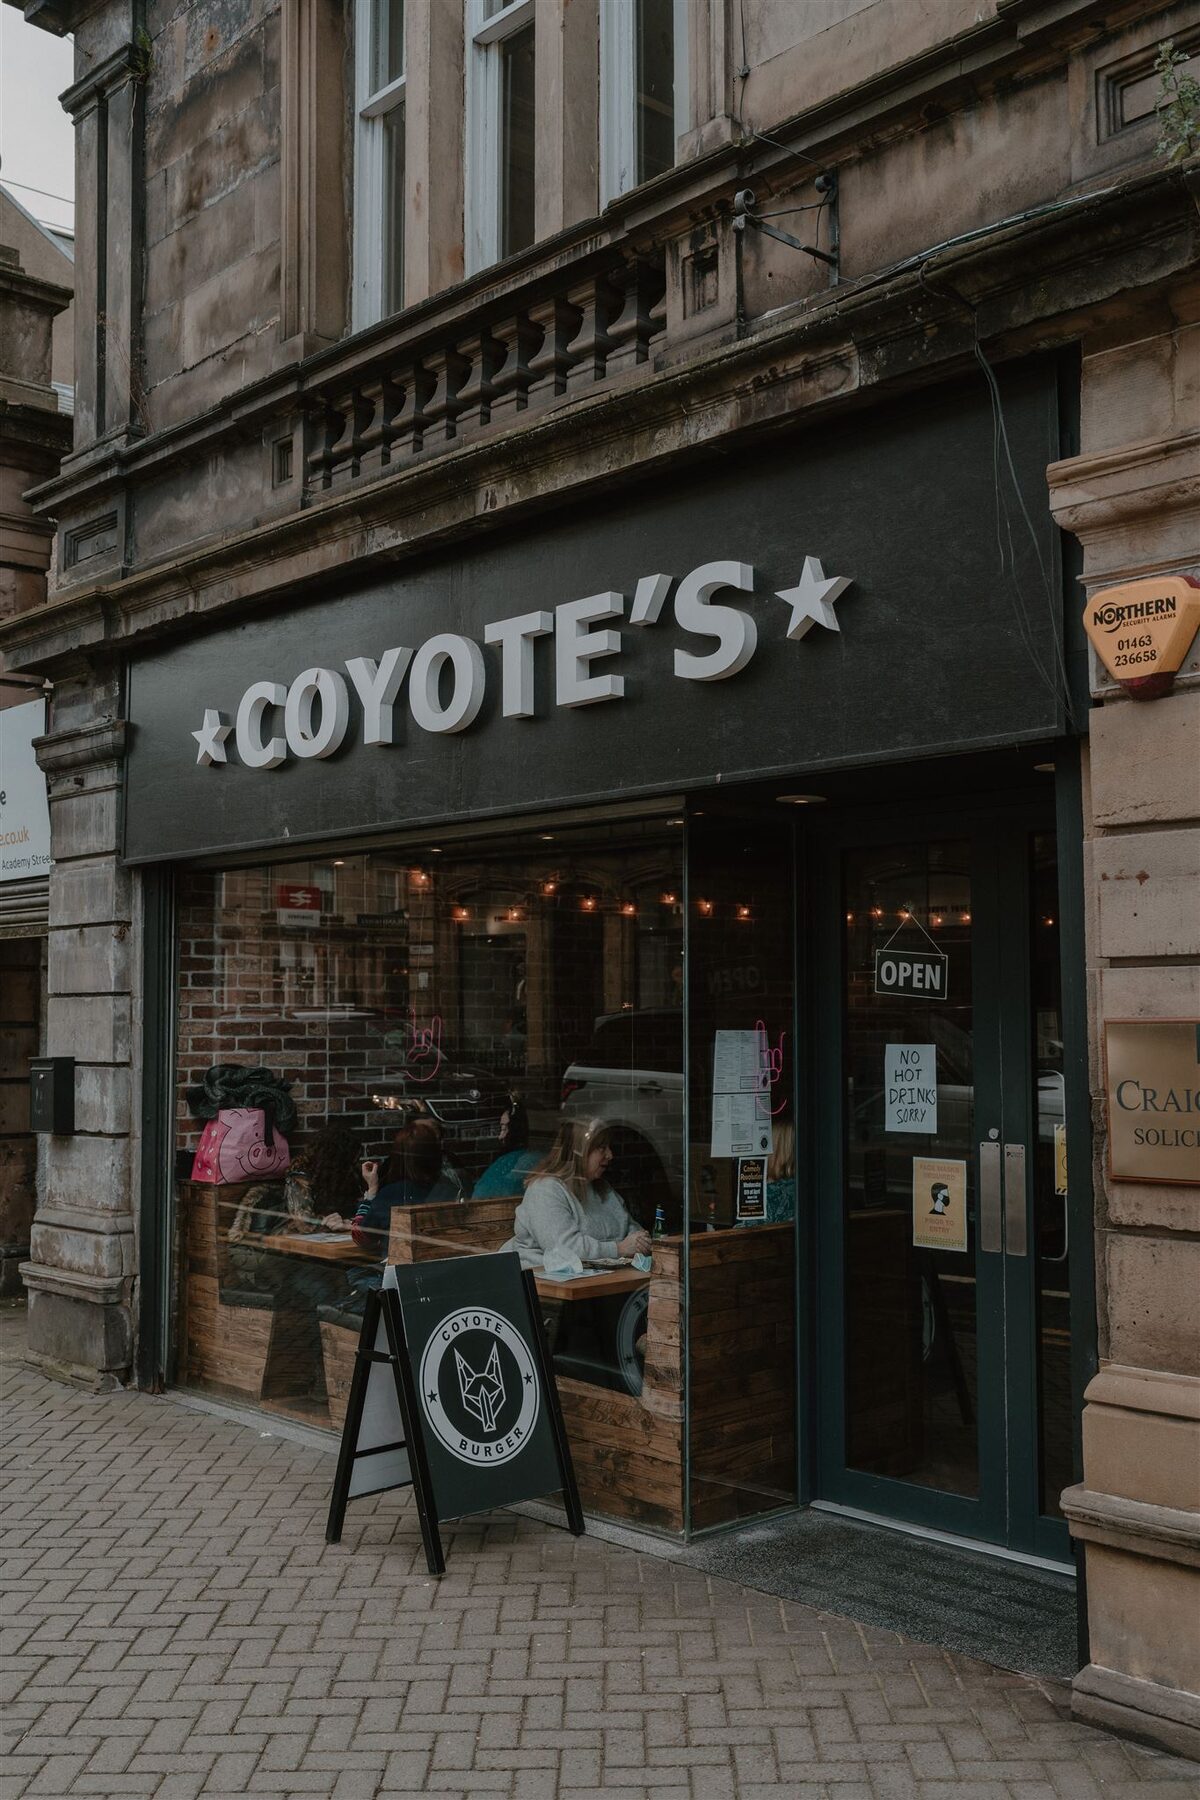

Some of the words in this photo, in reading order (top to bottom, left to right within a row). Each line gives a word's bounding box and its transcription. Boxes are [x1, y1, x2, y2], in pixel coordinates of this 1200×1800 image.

[1093, 596, 1177, 626] NORTHERN
[1122, 617, 1150, 628] SECURITY
[1152, 613, 1177, 623] ALARMS
[1117, 635, 1152, 651] 01463
[236, 561, 758, 769] COYOTE'S
[1114, 649, 1157, 667] 236658
[2, 856, 31, 870] Academy
[880, 960, 941, 990] OPEN
[899, 1049, 921, 1065] NO
[894, 1068, 922, 1083] HOT
[888, 1087, 937, 1105] DRINKS
[896, 1108, 926, 1124] SORRY
[441, 1315, 504, 1342] COYOTE
[458, 1427, 524, 1457] BURGER
